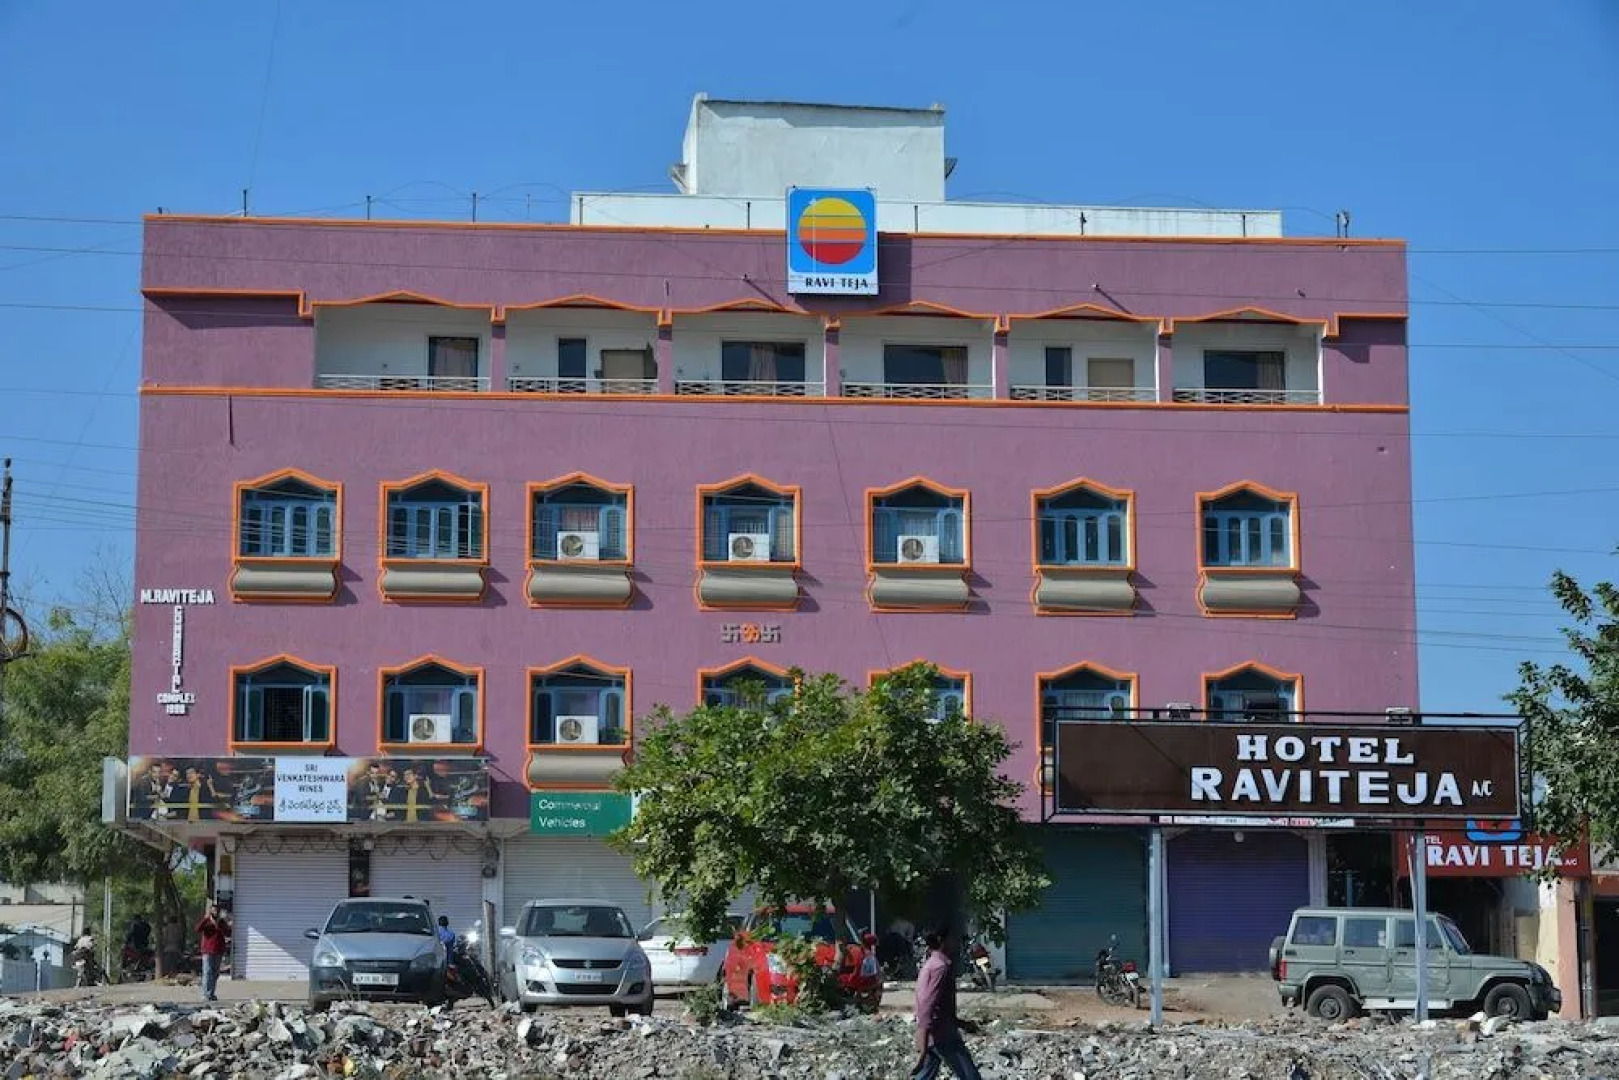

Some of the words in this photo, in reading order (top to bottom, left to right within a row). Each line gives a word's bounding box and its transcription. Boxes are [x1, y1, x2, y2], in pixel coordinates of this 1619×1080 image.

[805, 277, 835, 288] RAVI
[840, 277, 869, 290] TEJA
[1236, 734, 1414, 765] HOTEL
[305, 763, 318, 772] SRI
[276, 773, 346, 783] VENKATESHWARA
[298, 785, 323, 793] WINES
[1190, 767, 1463, 806] RAVITEJA
[1471, 780, 1492, 797] A/C
[538, 816, 587, 828] Vehicles
[1410, 835, 1443, 845] TEL
[1427, 844, 1490, 867] RAVI
[1501, 844, 1563, 870] TEJA
